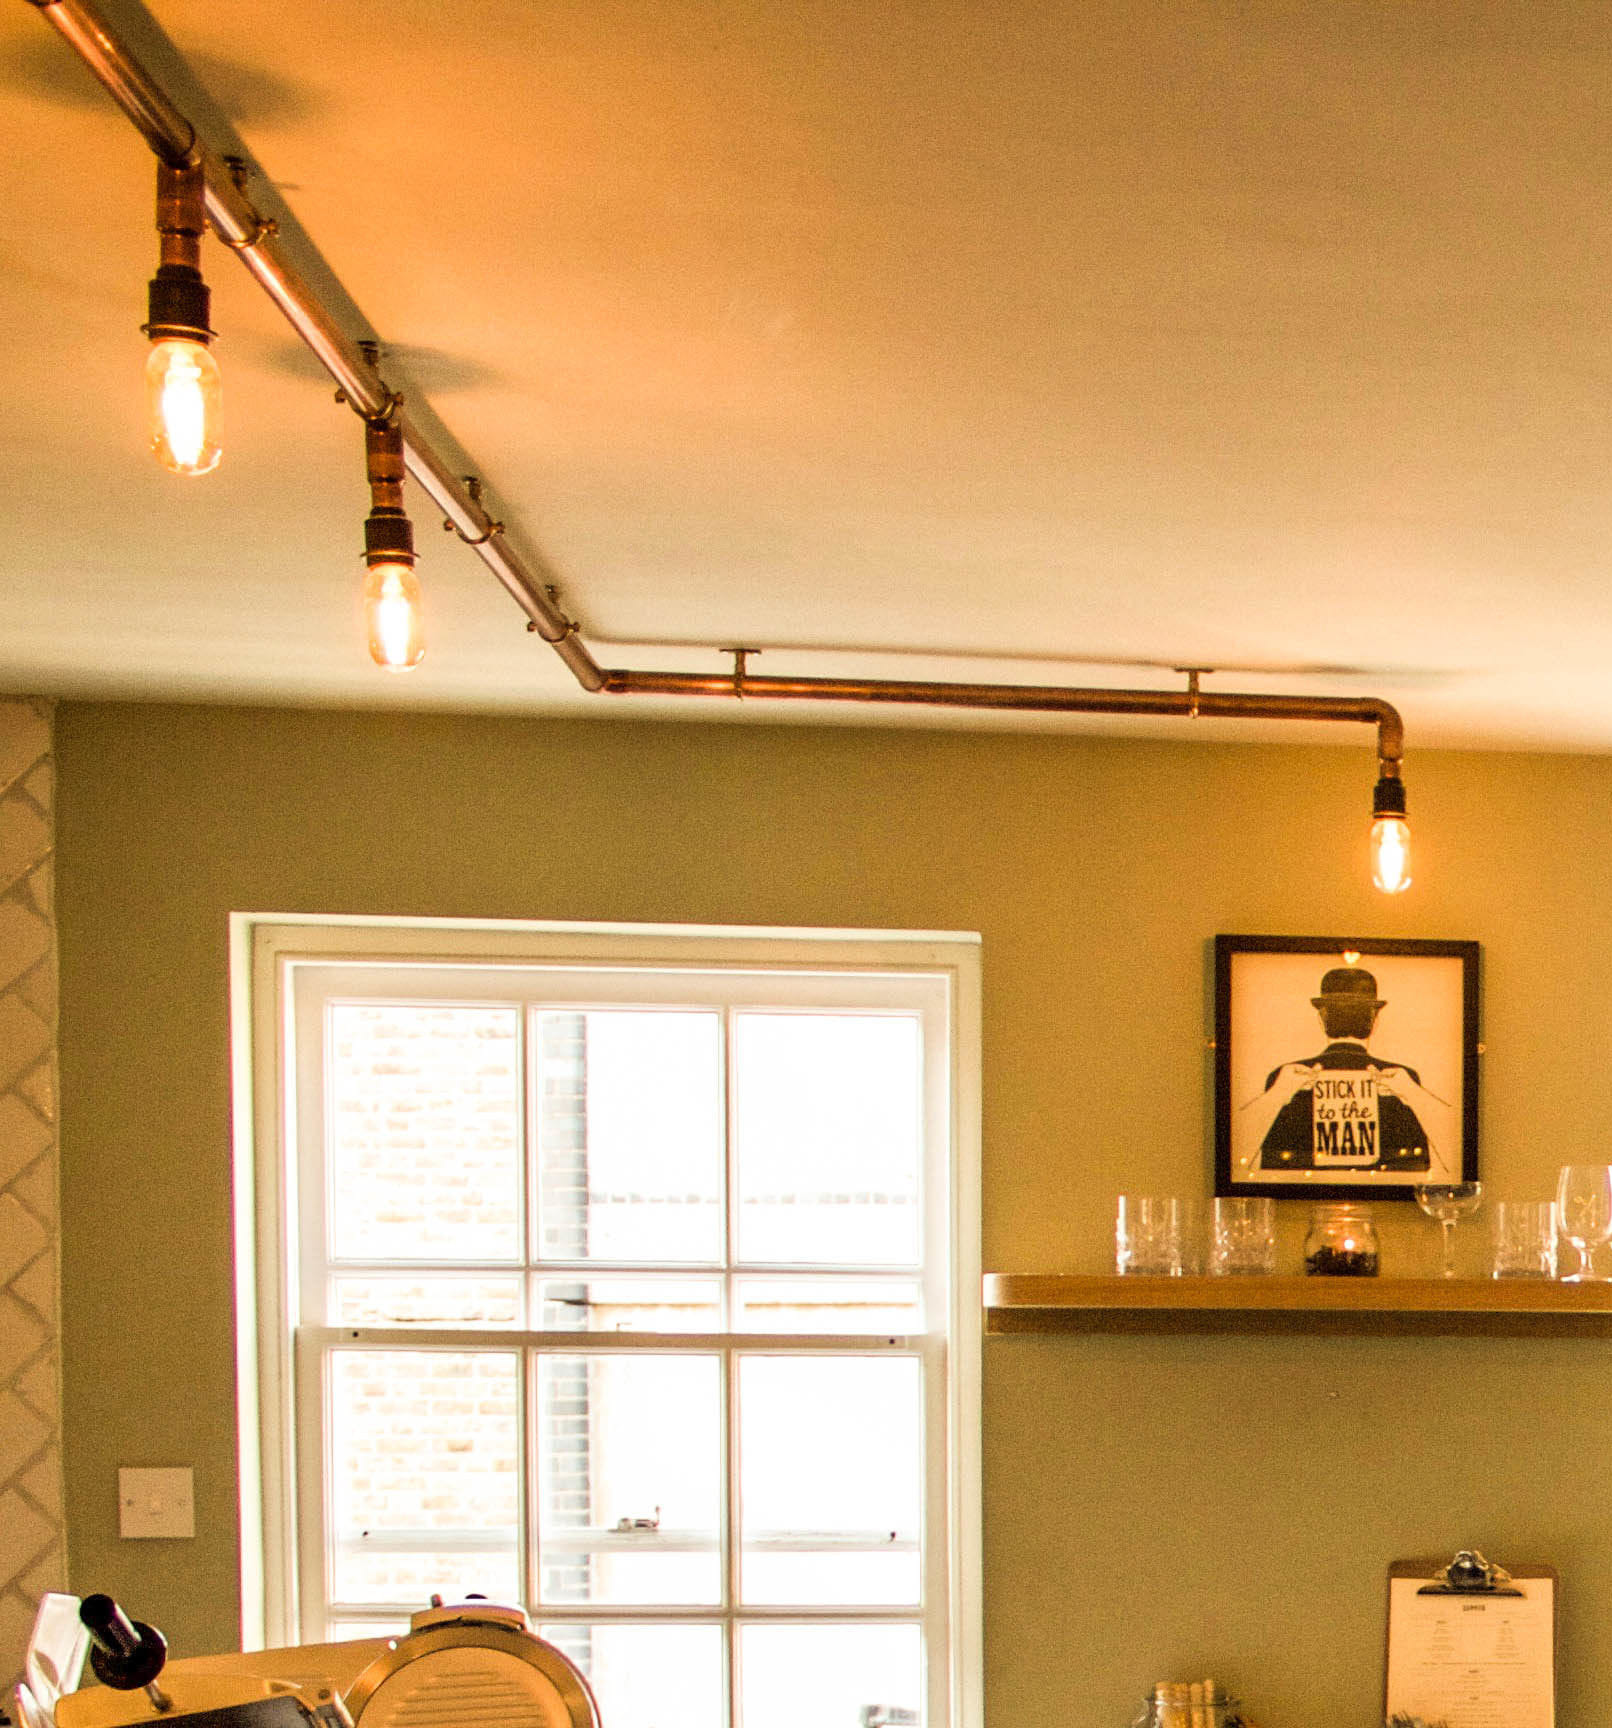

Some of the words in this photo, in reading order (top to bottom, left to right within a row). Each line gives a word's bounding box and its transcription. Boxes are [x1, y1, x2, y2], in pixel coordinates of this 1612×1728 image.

[1315, 1080, 1356, 1099] STICK
[1361, 1079, 1374, 1099] IT
[1317, 1103, 1336, 1120] to
[1339, 1100, 1373, 1119] the
[1316, 1121, 1376, 1156] MAN
